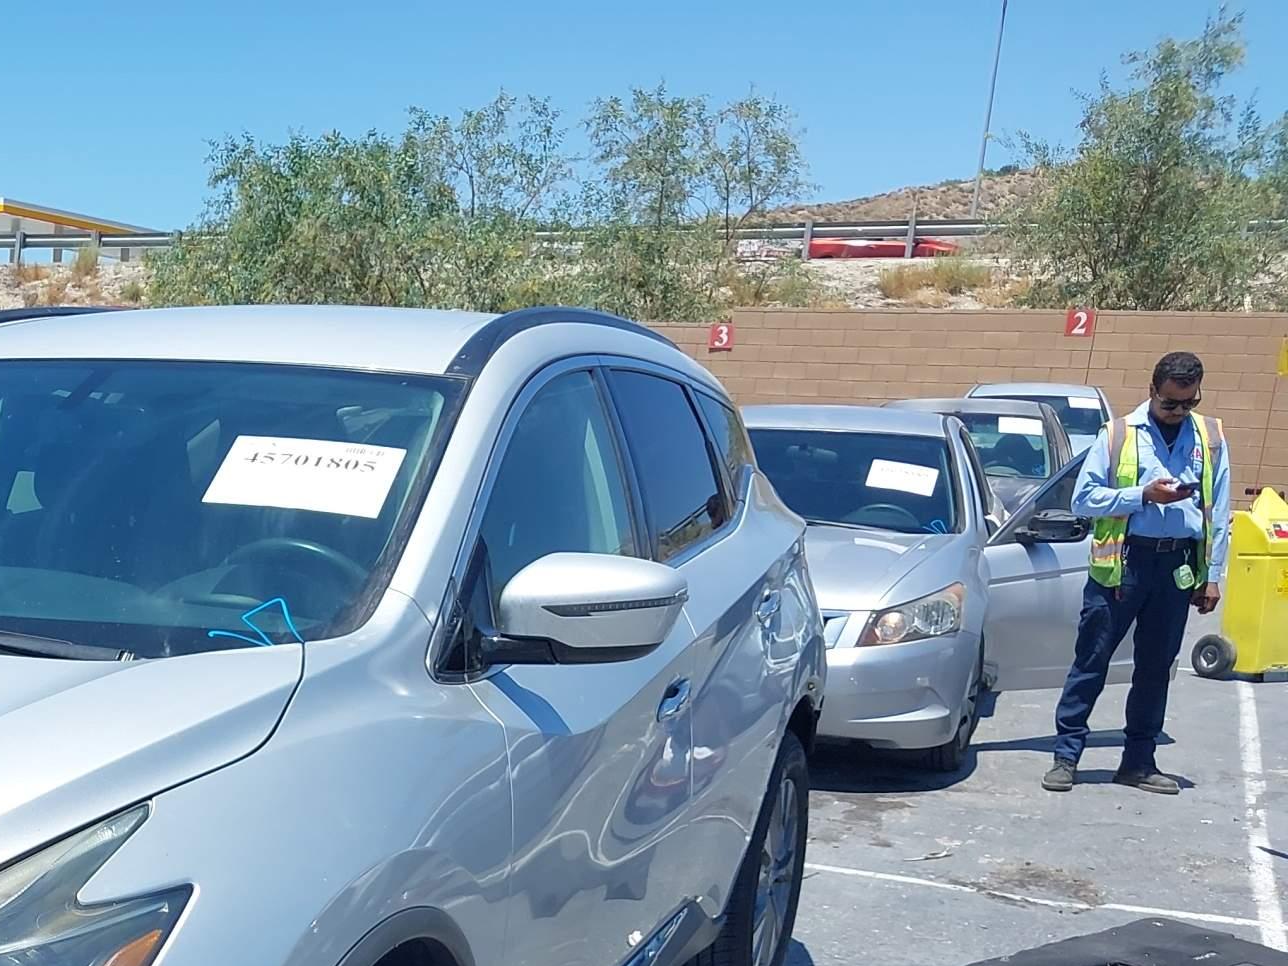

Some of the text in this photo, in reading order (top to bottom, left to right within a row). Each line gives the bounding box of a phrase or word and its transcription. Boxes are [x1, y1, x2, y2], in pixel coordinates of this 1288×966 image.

[1071, 311, 1088, 334] 2
[714, 325, 728, 346] 3
[243, 451, 377, 473] 45701805
